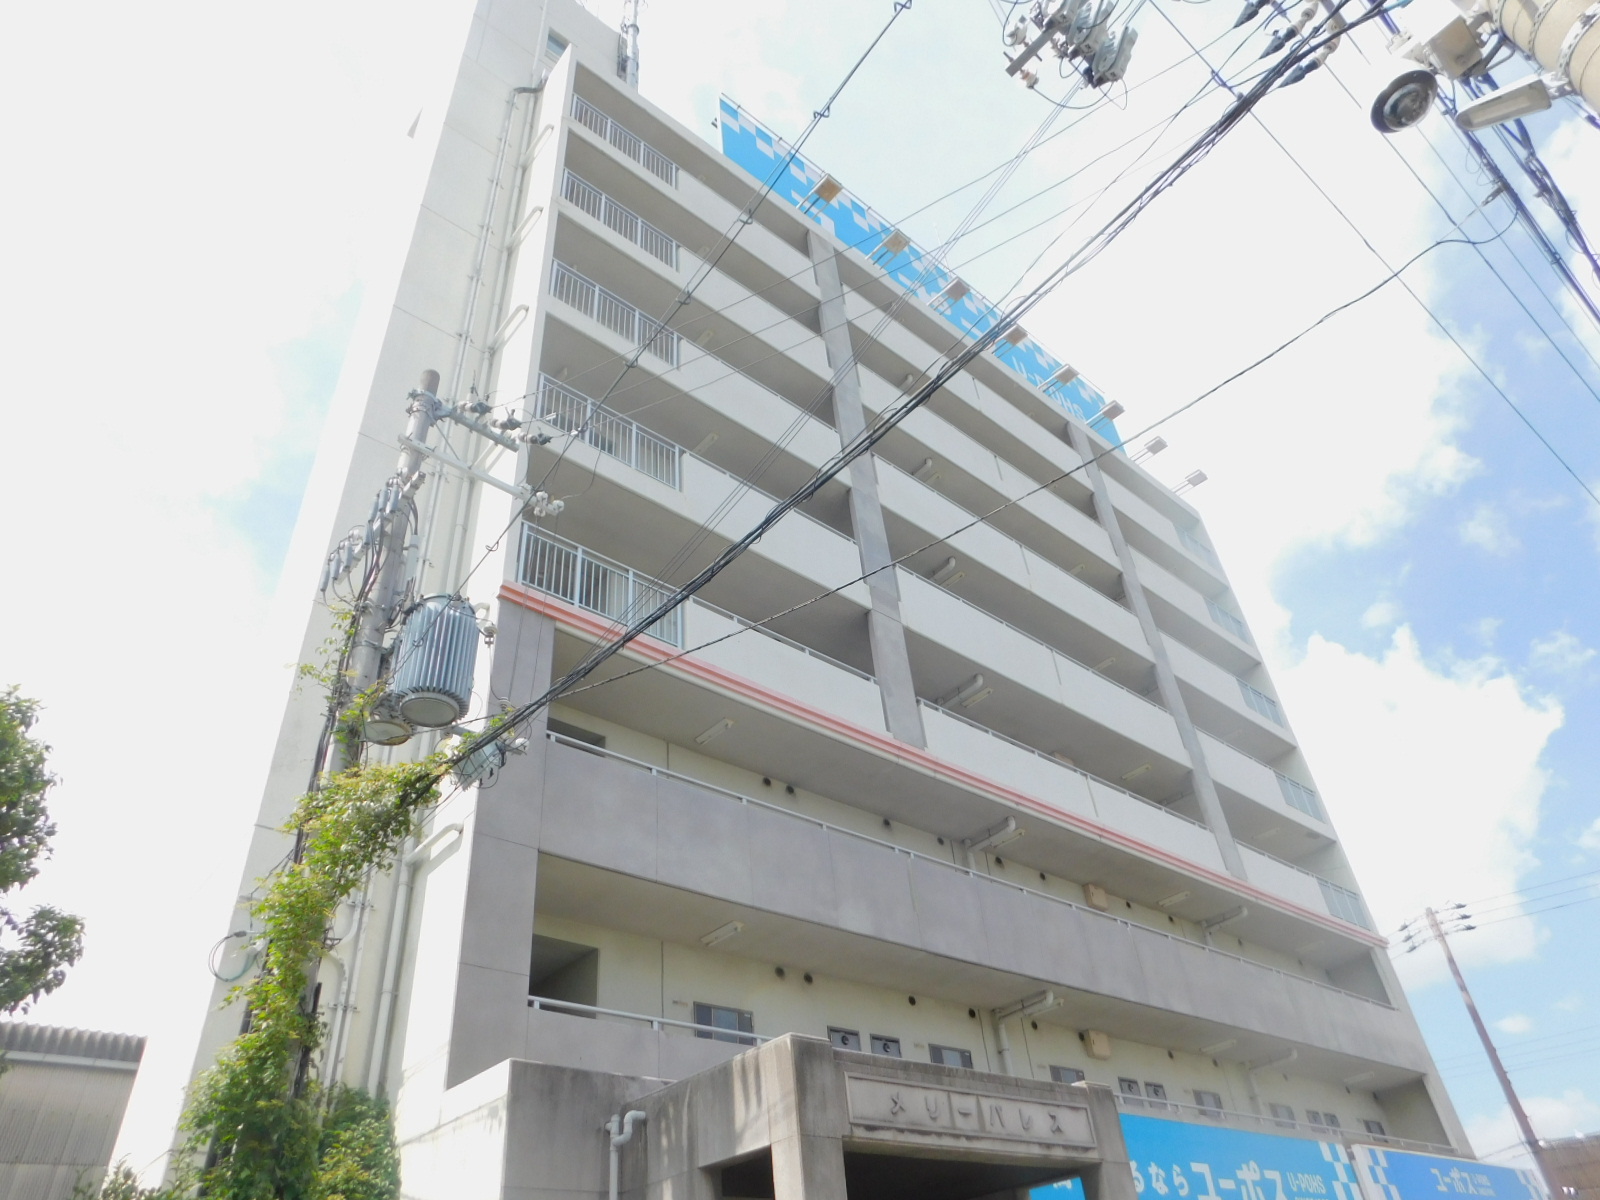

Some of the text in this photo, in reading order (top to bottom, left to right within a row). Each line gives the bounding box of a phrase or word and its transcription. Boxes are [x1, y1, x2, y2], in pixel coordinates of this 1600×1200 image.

[1286, 1171, 1327, 1195] U-POHS
[1429, 1166, 1479, 1195] ユーポス
